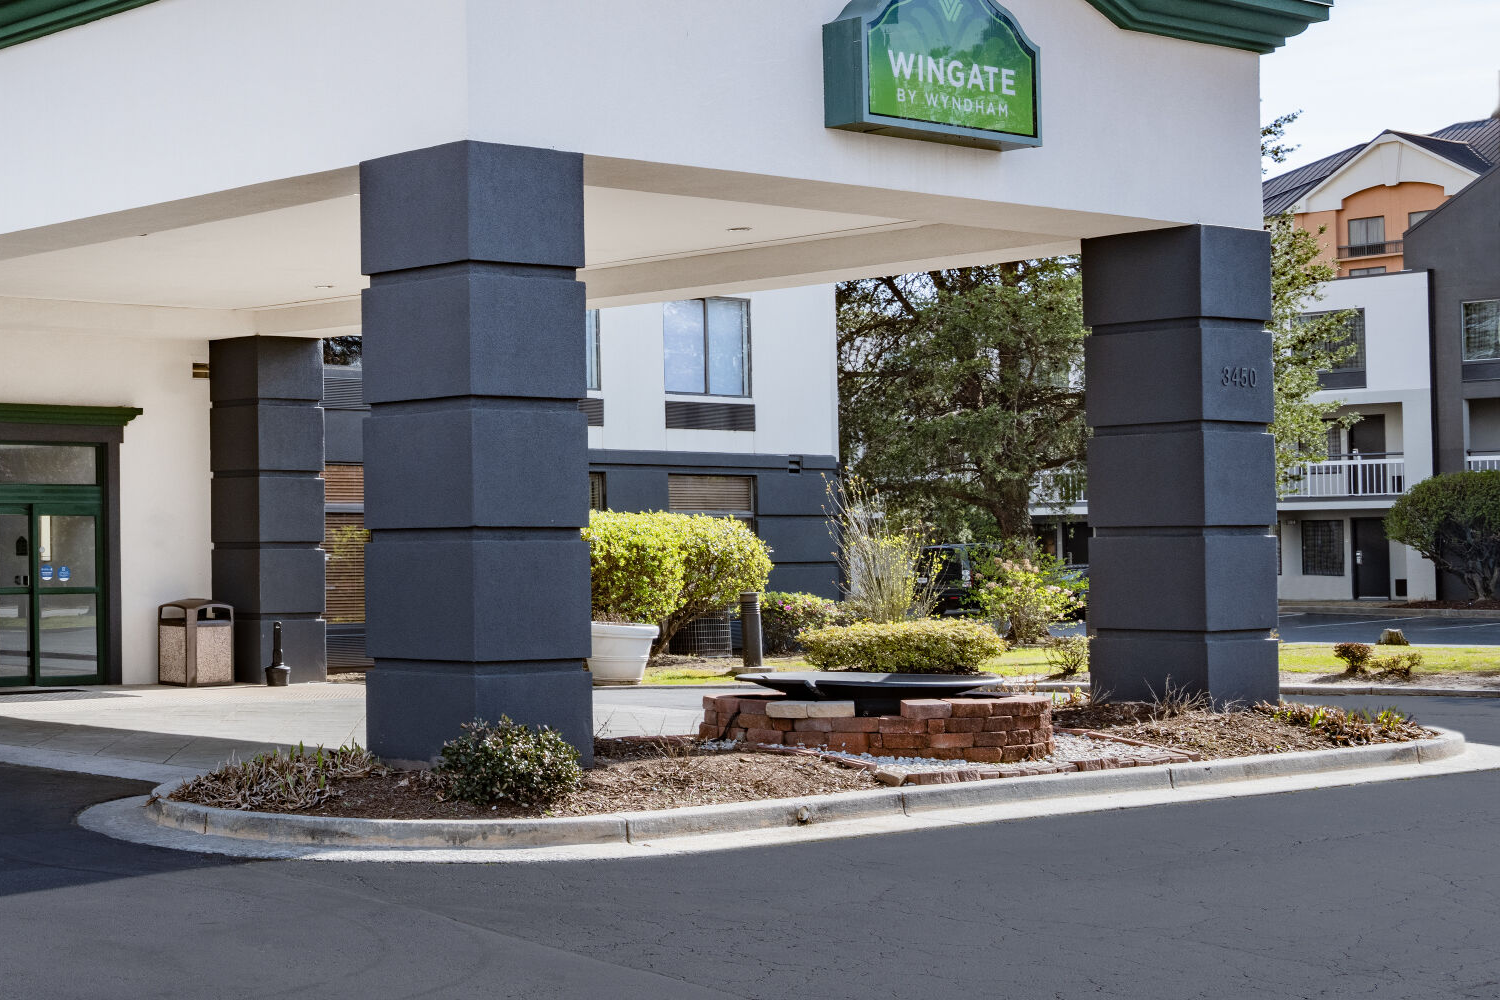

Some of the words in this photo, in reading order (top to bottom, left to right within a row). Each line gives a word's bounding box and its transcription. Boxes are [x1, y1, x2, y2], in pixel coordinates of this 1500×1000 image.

[887, 49, 1016, 96] WINGATE
[897, 88, 917, 104] BY
[925, 92, 1009, 118] WYNDHAM
[1221, 366, 1257, 388] 3450
